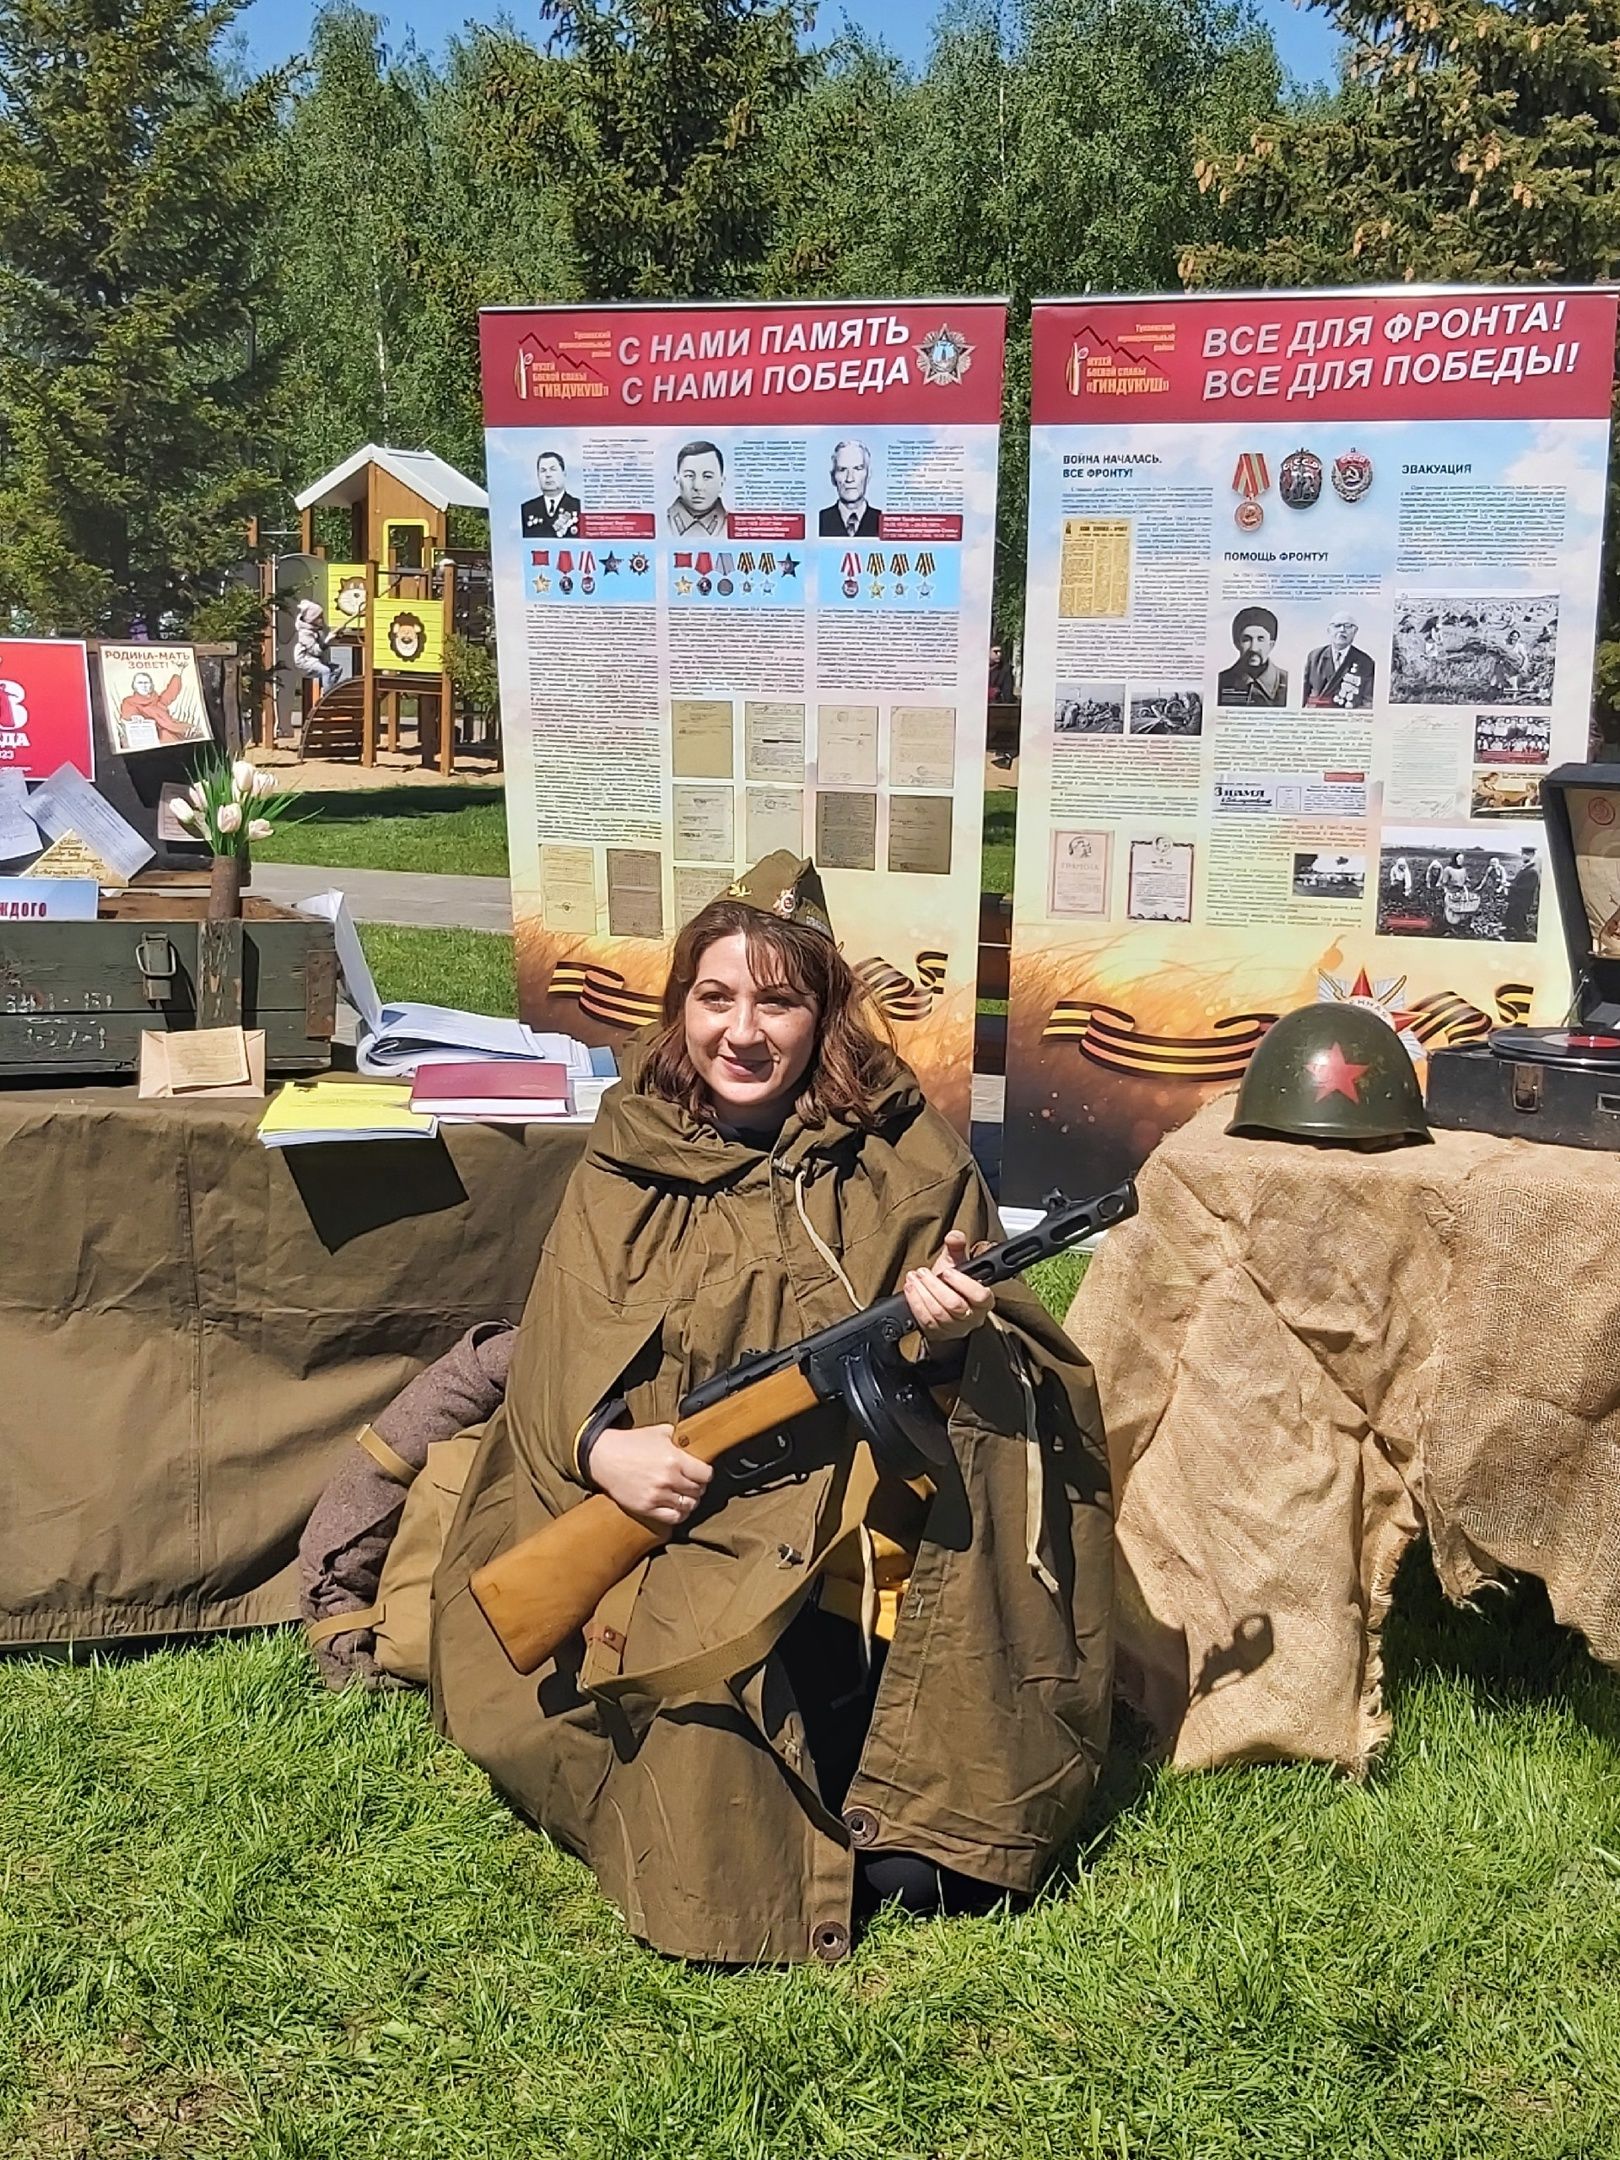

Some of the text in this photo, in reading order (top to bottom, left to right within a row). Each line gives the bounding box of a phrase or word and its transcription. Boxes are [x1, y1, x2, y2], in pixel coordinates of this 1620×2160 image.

[1202, 300, 1567, 359] ВСЕ ДЛЯ ФРОНТА!
[619, 315, 910, 366] С НАМИ ПАМЯТЬ
[1202, 342, 1581, 402] ВСЕ ДЛЯ ПОБЕДЫ!
[621, 356, 910, 406] С НАМИ ПОБЕДА
[1086, 377, 1169, 396] «ГИНДУКУШ»
[1063, 453, 1162, 464] ВОЙНА НАЧАЛАСЬ.
[1063, 468, 1133, 478] ВСЕ ФРОНТУ!
[1401, 464, 1472, 475] ЭВАКУАЦИЯ
[1224, 552, 1328, 562] ПОМОЩЬ ФРОНТУ!
[105, 650, 190, 662] РОДИНА-МАТЬ
[1214, 786, 1265, 797] Знамя
